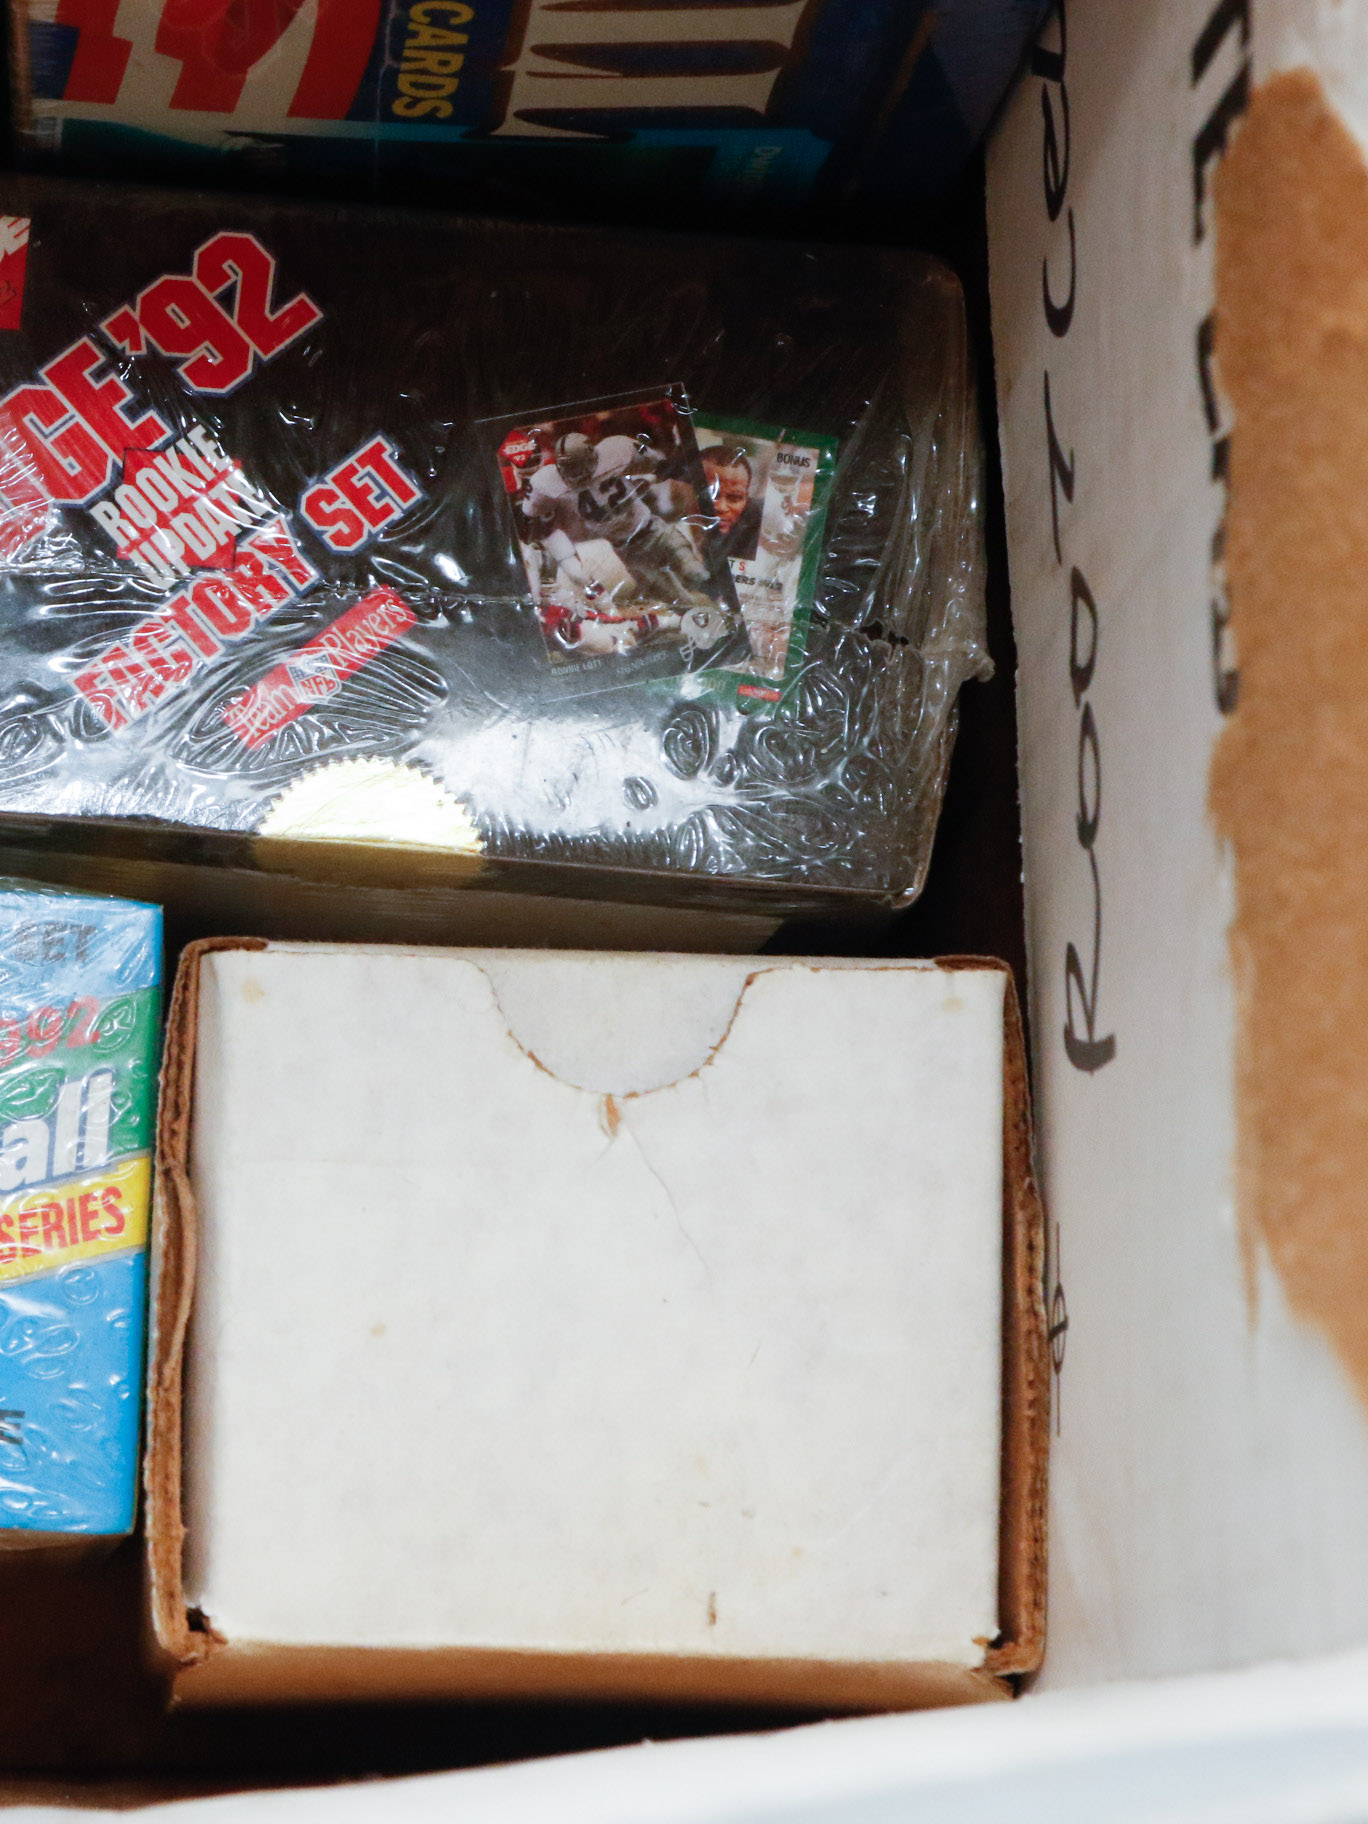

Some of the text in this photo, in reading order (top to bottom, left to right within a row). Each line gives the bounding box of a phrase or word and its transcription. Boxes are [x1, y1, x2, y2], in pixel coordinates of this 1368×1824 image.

[392, 1, 474, 118] CARDS
[99, 230, 323, 394] '92
[89, 423, 232, 549] ROOKIE
[504, 439, 537, 455] EDGE
[777, 452, 811, 468] BONUS
[65, 434, 425, 732] FACTORY SET
[128, 468, 274, 589] UPDATE
[229, 684, 297, 738] Team
[318, 597, 408, 668] Players
